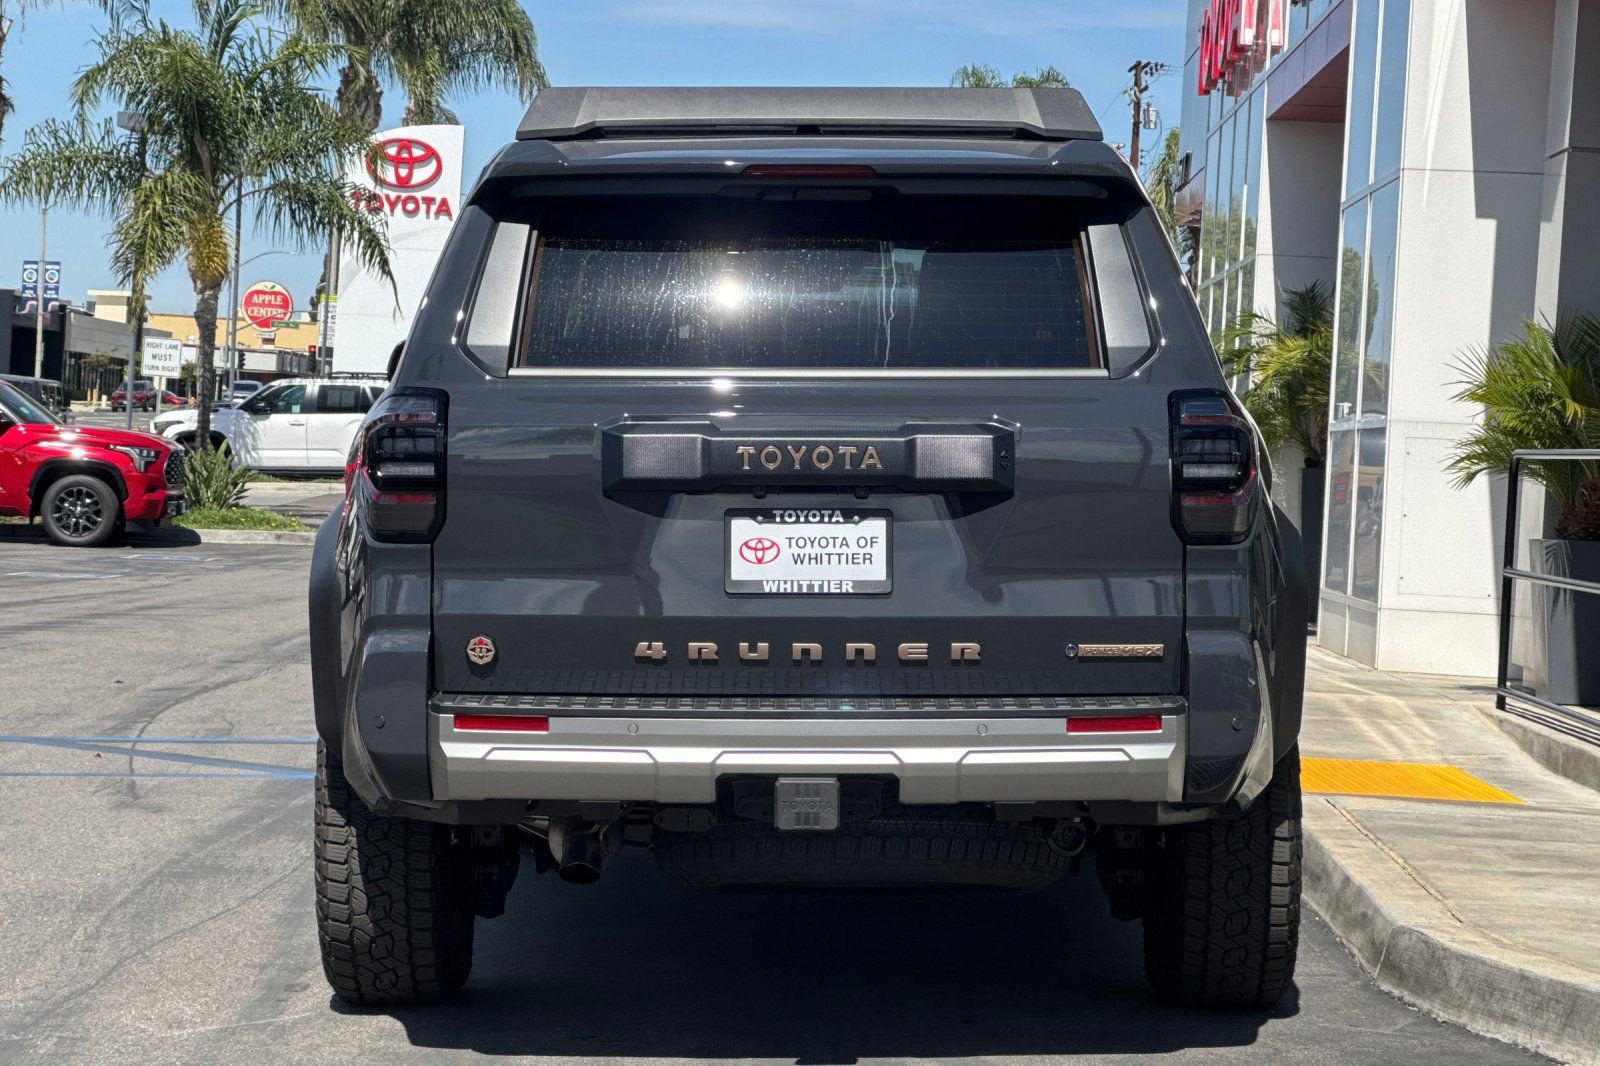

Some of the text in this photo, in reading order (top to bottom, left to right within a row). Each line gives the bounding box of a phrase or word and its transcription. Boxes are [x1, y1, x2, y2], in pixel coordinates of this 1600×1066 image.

[252, 294, 283, 305] APPLE
[248, 306, 285, 318] CENTER
[146, 341, 179, 350] RIGHT LANE
[152, 353, 172, 361] MUST
[735, 445, 884, 471] TOYOTA
[772, 509, 844, 524] TOYOTA
[785, 536, 880, 549] TOYOTA OF
[791, 551, 874, 566] WHITTIER
[762, 579, 854, 593] WHITTIER
[633, 641, 983, 662] 4RUNNER
[780, 800, 835, 812] TOYOTA
